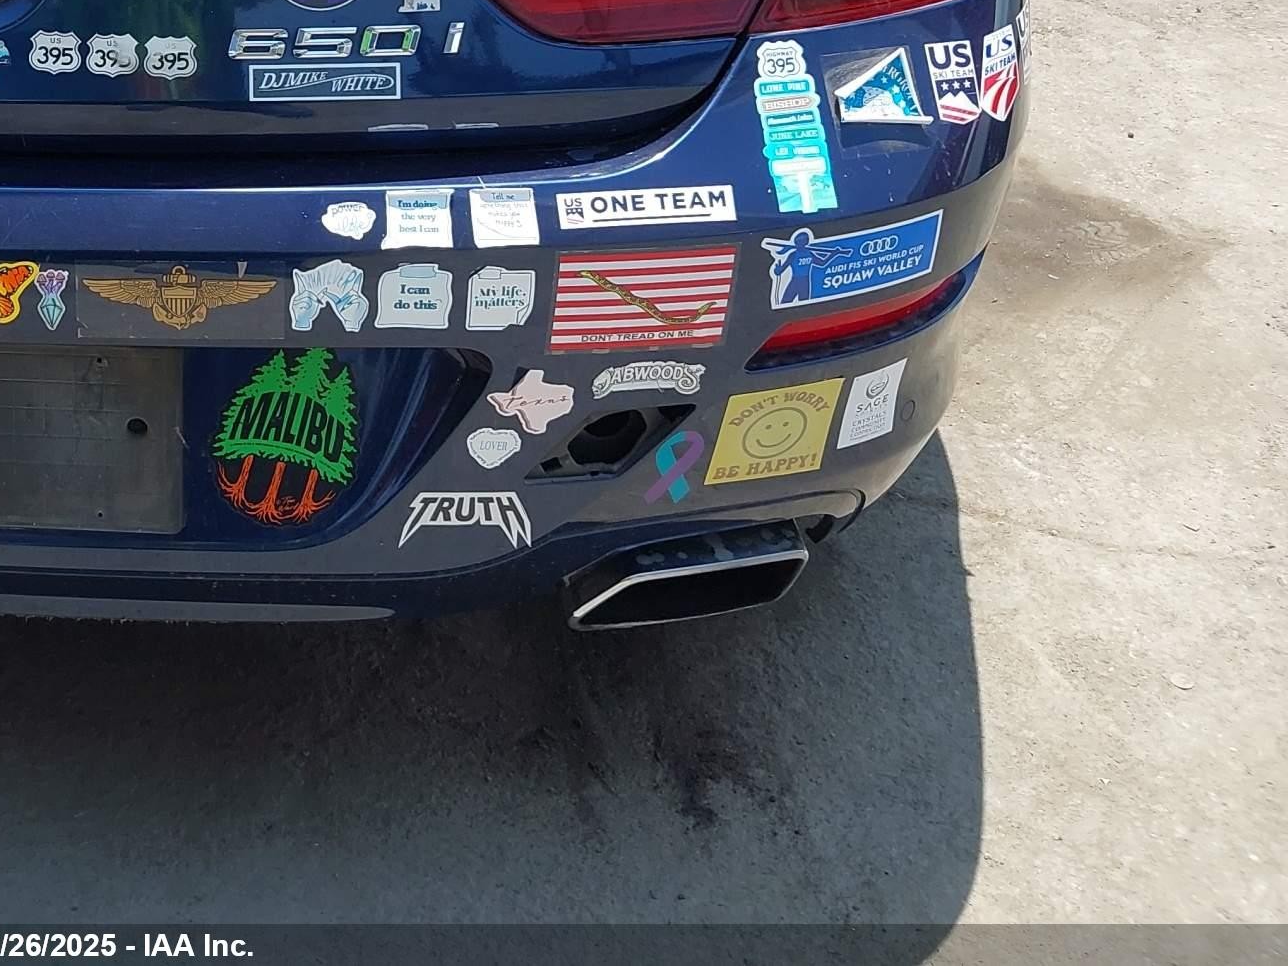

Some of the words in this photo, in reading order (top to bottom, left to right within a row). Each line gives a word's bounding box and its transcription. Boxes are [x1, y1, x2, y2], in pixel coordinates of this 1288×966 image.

[985, 33, 1013, 59] US
[37, 46, 73, 66] 395
[152, 52, 190, 71] 395
[927, 43, 971, 69] US
[984, 64, 999, 75] SKI
[999, 52, 1016, 70] TEAM
[766, 58, 796, 74] 395
[932, 71, 949, 79] SKI
[951, 68, 974, 78] TEAM
[329, 76, 389, 93] WHITE
[764, 97, 810, 111] BISHOP
[397, 200, 412, 209] I'm
[413, 199, 438, 210] doing
[491, 192, 505, 201] Tell
[564, 197, 582, 208] US
[590, 194, 646, 214] ONE
[654, 190, 727, 210] TEAM
[401, 212, 416, 221] the
[418, 214, 436, 223] very
[399, 225, 418, 233] best
[825, 263, 847, 274] AUDI
[848, 261, 862, 270] FIS
[863, 258, 877, 267] SKI
[878, 250, 907, 263] WORLD
[908, 244, 924, 255] CUP
[822, 268, 874, 289] SQUAW
[877, 254, 923, 277] VALLEY
[400, 284, 406, 294] I
[406, 286, 430, 295] can
[393, 299, 411, 310] do
[413, 300, 438, 310] this
[617, 332, 655, 341] TREAD
[657, 331, 675, 339] ON
[677, 329, 695, 338] ME
[503, 395, 570, 410] Texas
[728, 394, 779, 427] DON'T
[783, 391, 831, 413] WORRY
[855, 393, 890, 413] SAGE
[229, 391, 345, 464] MALIBU
[479, 440, 508, 451] LOVER
[712, 465, 740, 480] BE
[744, 452, 818, 476] HAPPY!
[401, 496, 528, 542] TRUTH
